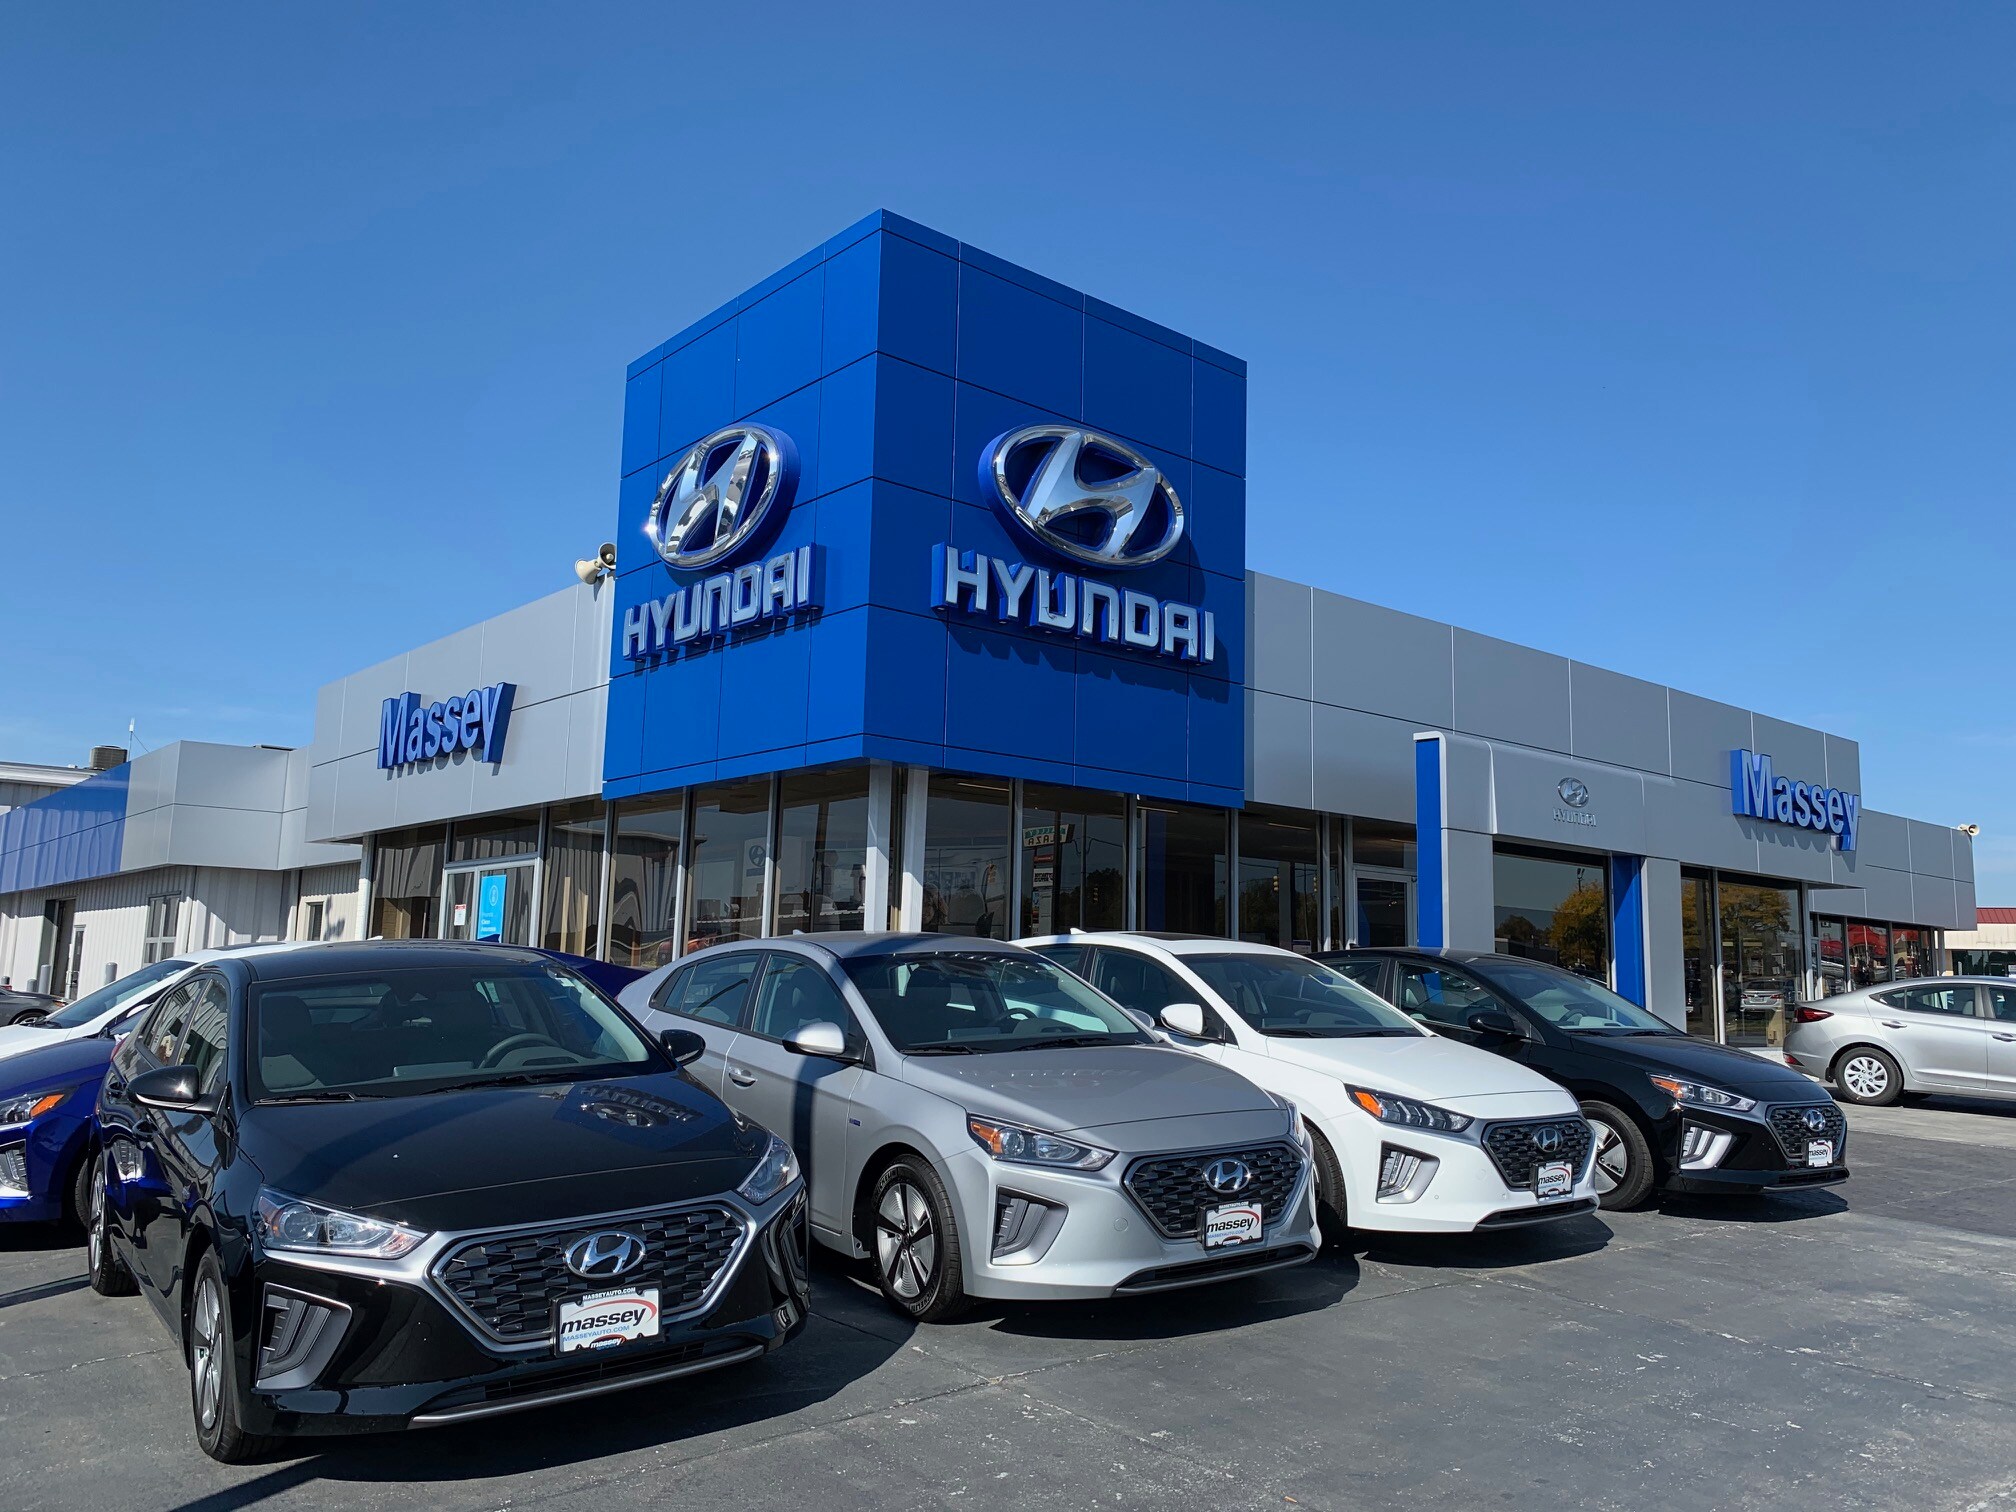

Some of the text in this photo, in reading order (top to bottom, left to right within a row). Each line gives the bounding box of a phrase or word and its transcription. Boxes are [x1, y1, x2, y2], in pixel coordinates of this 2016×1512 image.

[623, 543, 818, 660] HYUNDAI
[938, 543, 1215, 663] HYUNDAI
[378, 682, 515, 769] Massey
[1734, 748, 1859, 851] Massey
[1553, 807, 1597, 827] HYUNDAI
[1538, 1173, 1566, 1185] massey
[1207, 1217, 1254, 1233] massey
[582, 1286, 636, 1301] MASSEYAUTO.COM
[560, 1307, 646, 1335] massey
[562, 1325, 630, 1342] MASSEYAUTO.COM
